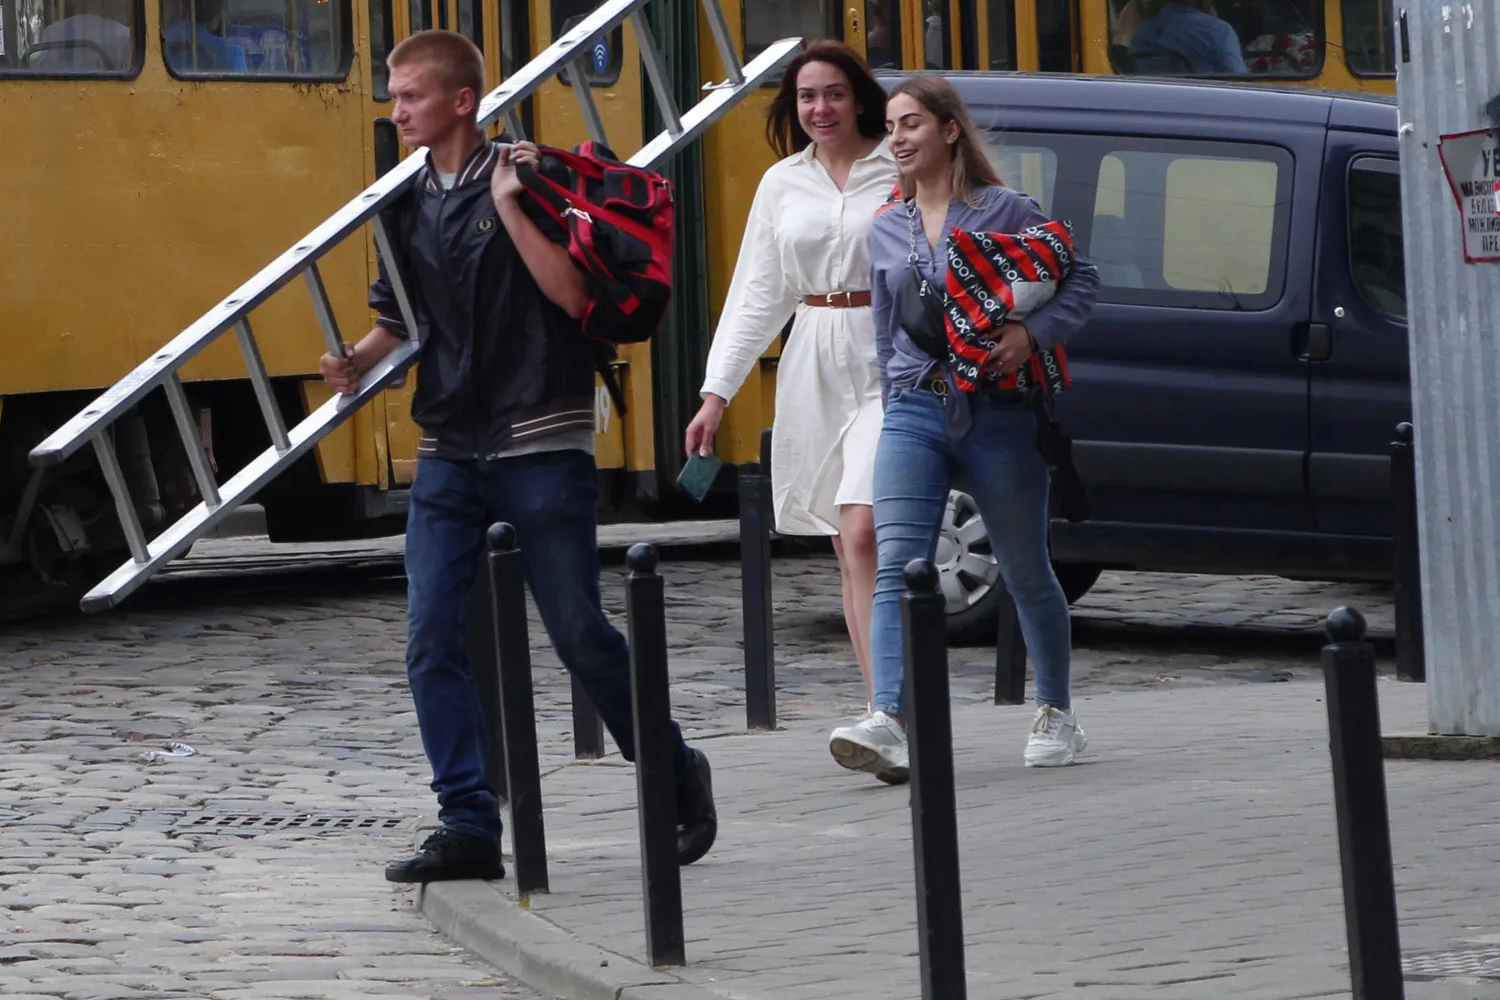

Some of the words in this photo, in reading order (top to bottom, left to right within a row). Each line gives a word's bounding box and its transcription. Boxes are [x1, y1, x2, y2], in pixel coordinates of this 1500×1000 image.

[1045, 236, 1070, 265] JOOM
[1482, 235, 1500, 252] ПРЕ
[946, 247, 975, 282] JOOM
[992, 252, 1024, 285] JOOM
